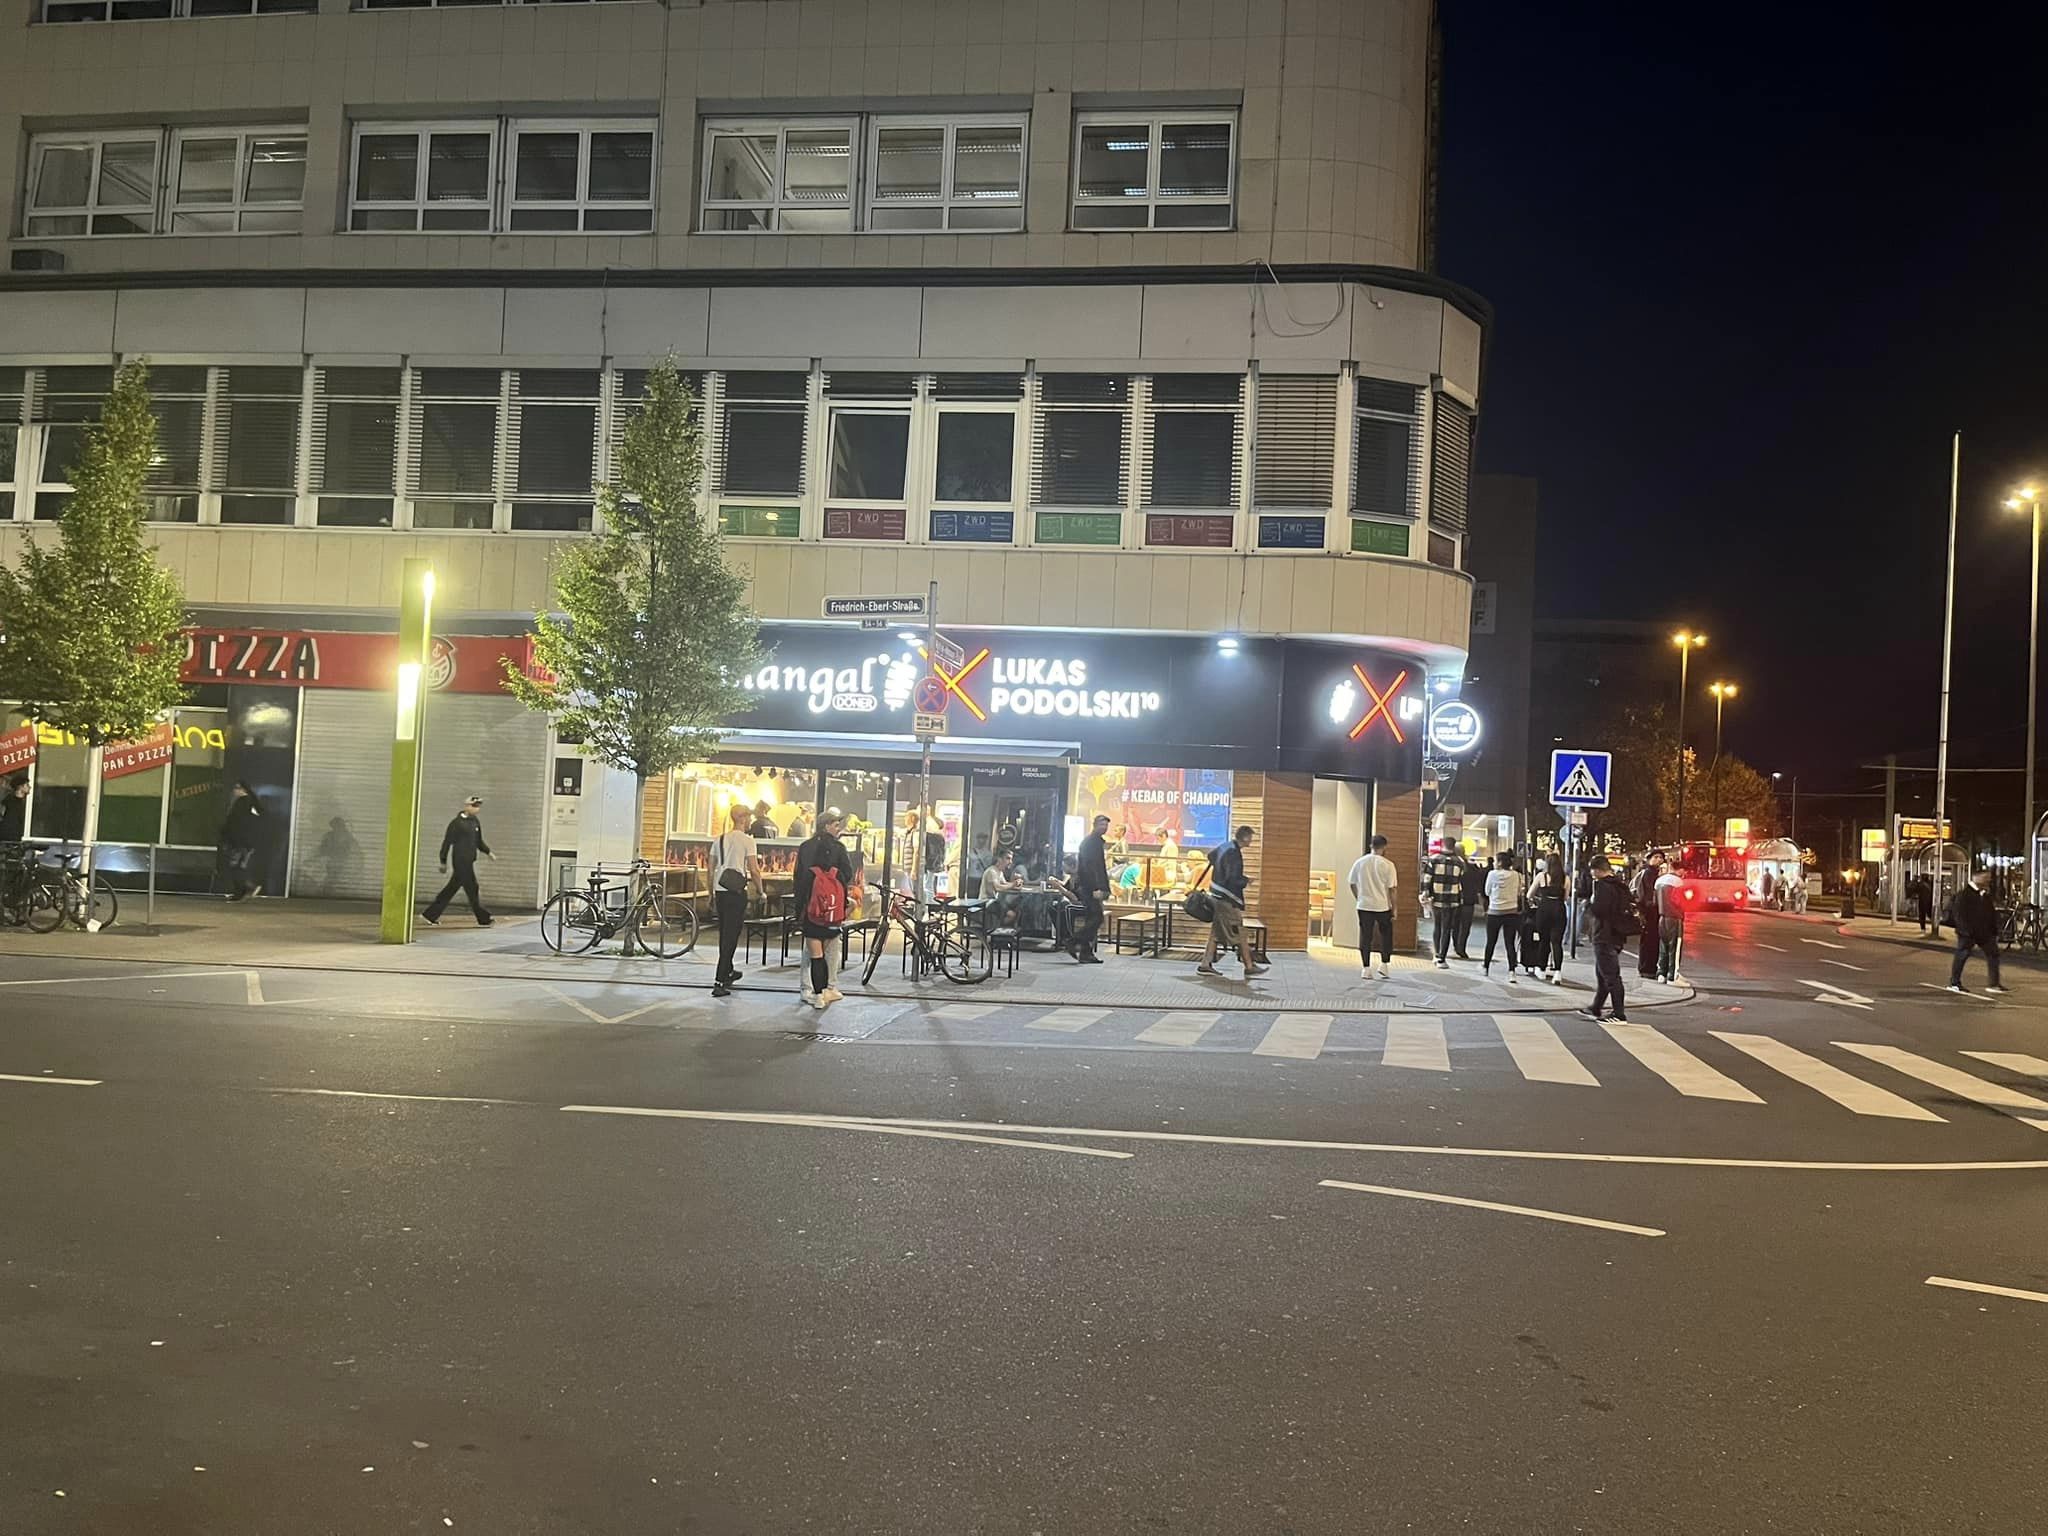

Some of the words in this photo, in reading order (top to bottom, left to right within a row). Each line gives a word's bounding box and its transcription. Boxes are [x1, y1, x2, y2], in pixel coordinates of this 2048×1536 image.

[964, 514, 986, 525] ZWD
[1180, 519, 1204, 529] ZWD
[992, 657, 1087, 687] LUKAS
[3, 745, 36, 765] PIZZA
[103, 756, 124, 772] PAN
[138, 744, 173, 763] PIZZA
[1166, 790, 1179, 805] OF
